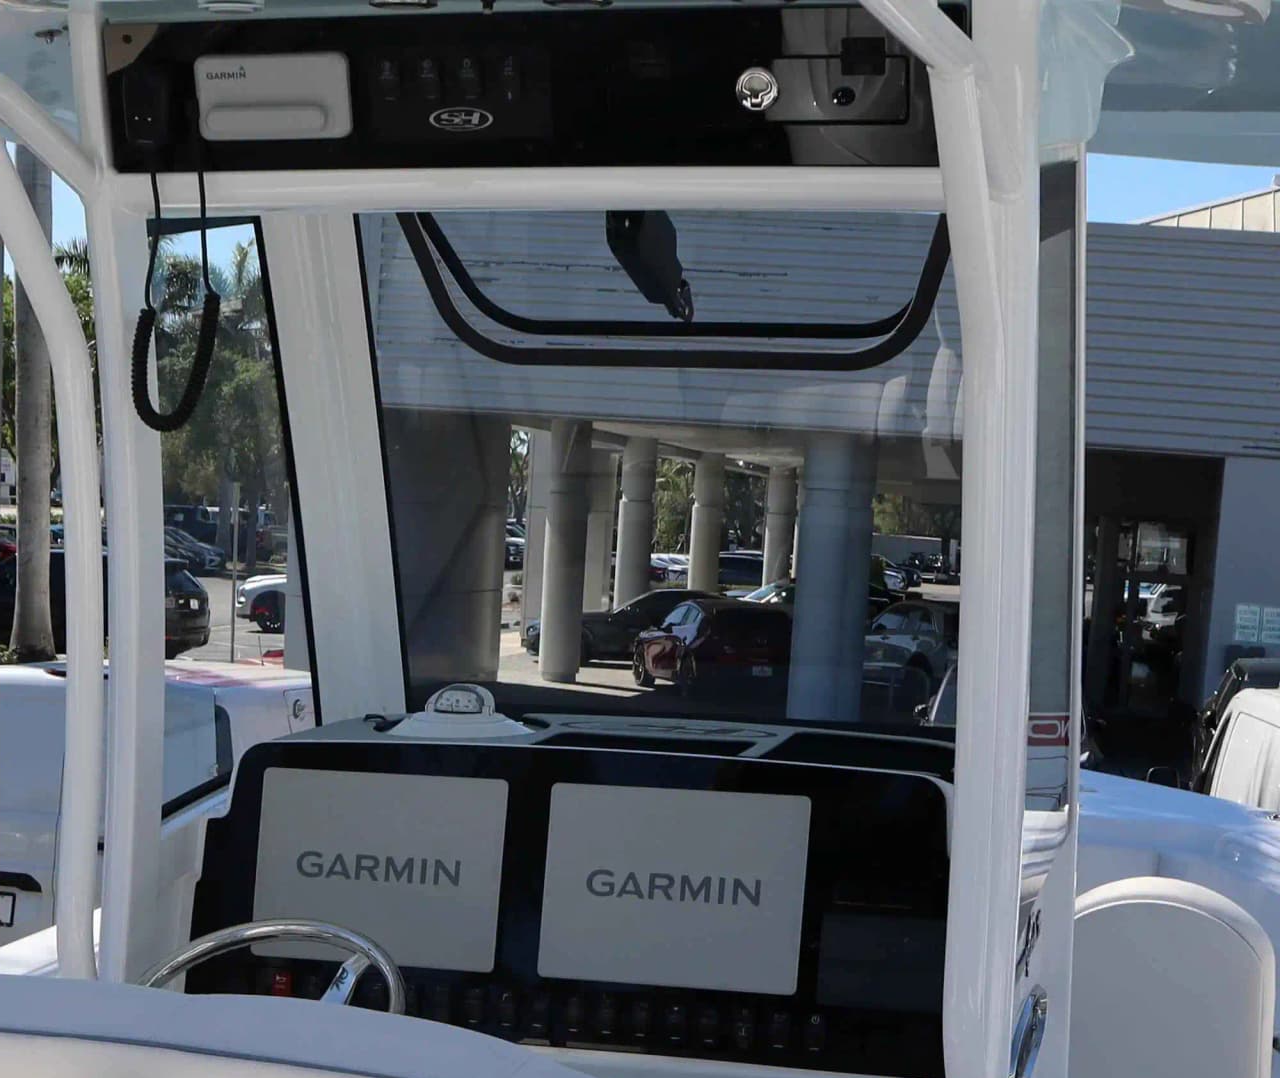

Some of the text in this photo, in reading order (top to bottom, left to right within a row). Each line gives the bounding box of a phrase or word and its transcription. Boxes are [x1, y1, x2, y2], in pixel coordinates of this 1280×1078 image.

[206, 72, 246, 80] GARMIN
[296, 850, 462, 887] GARMIN
[586, 869, 762, 907] GARMIN
